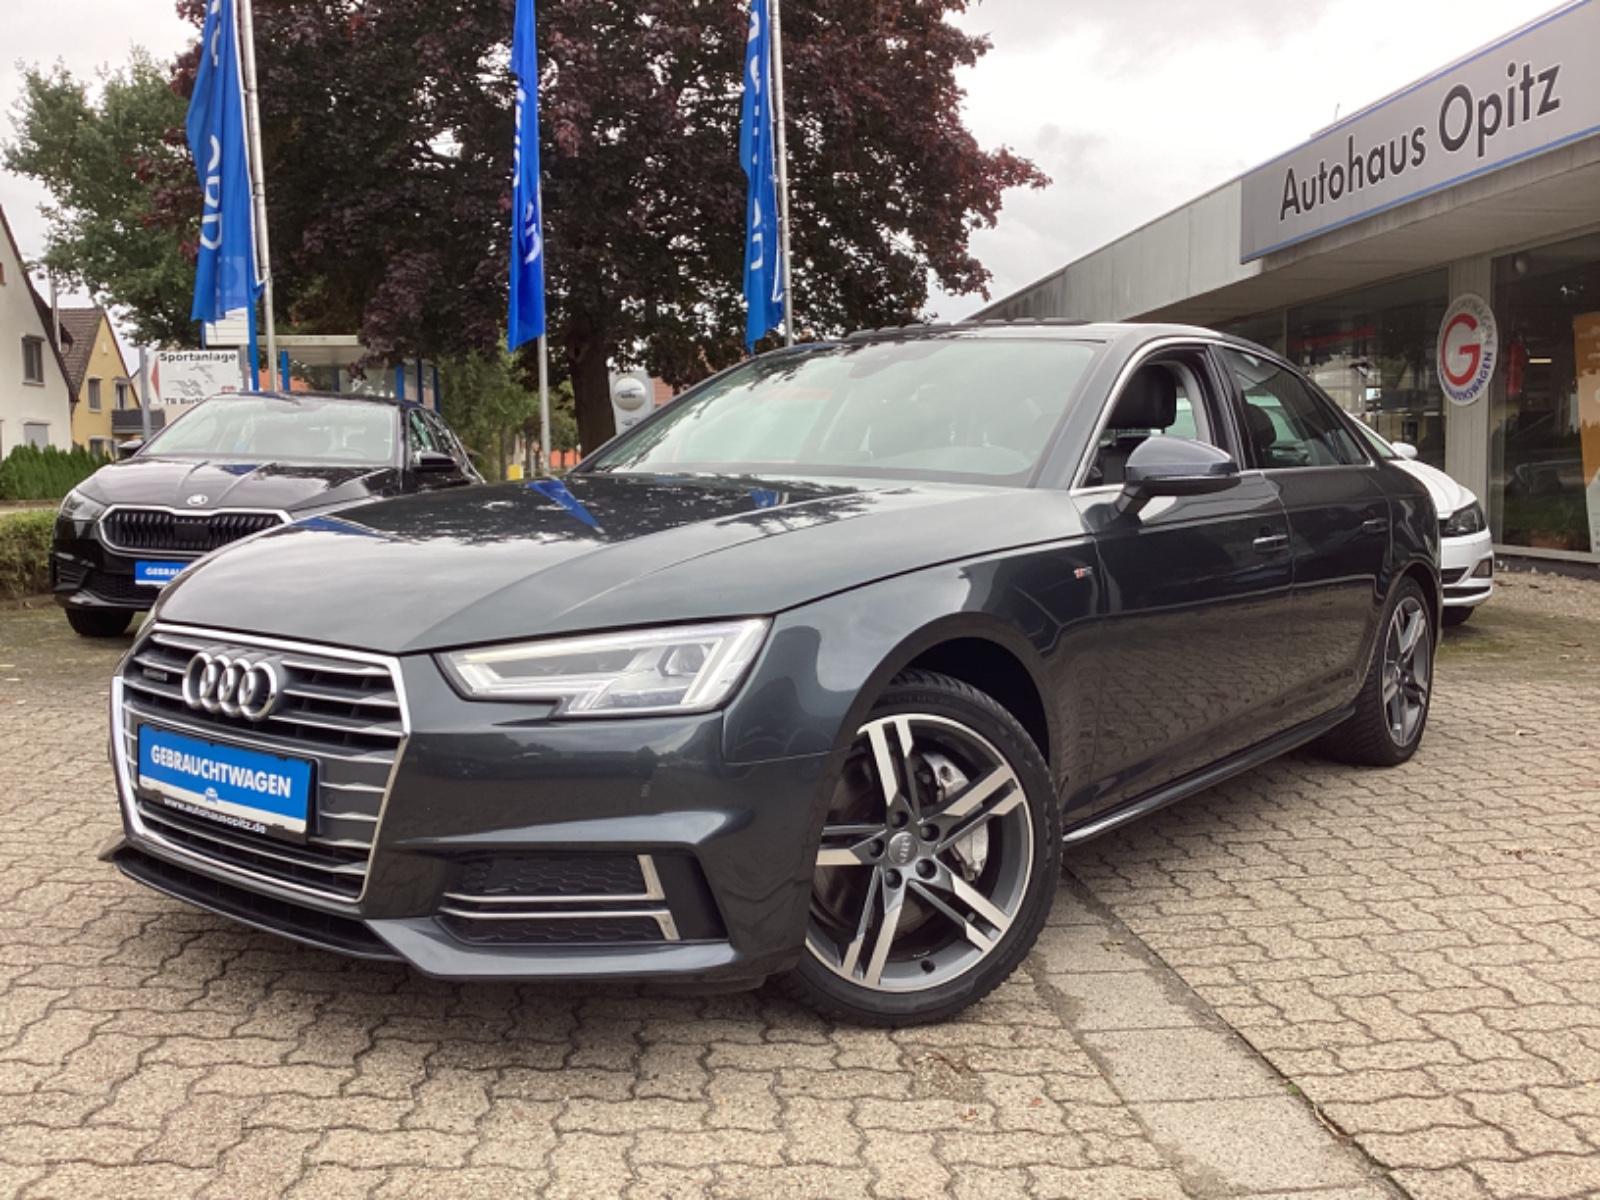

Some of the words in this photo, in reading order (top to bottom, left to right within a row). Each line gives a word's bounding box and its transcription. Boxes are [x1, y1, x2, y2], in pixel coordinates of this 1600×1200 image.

[1280, 126, 1427, 221] Autohaus
[1438, 62, 1561, 158] Opitz
[160, 352, 236, 363] Sportanlage
[151, 744, 292, 799] GEBRAUCHTWAGEN
